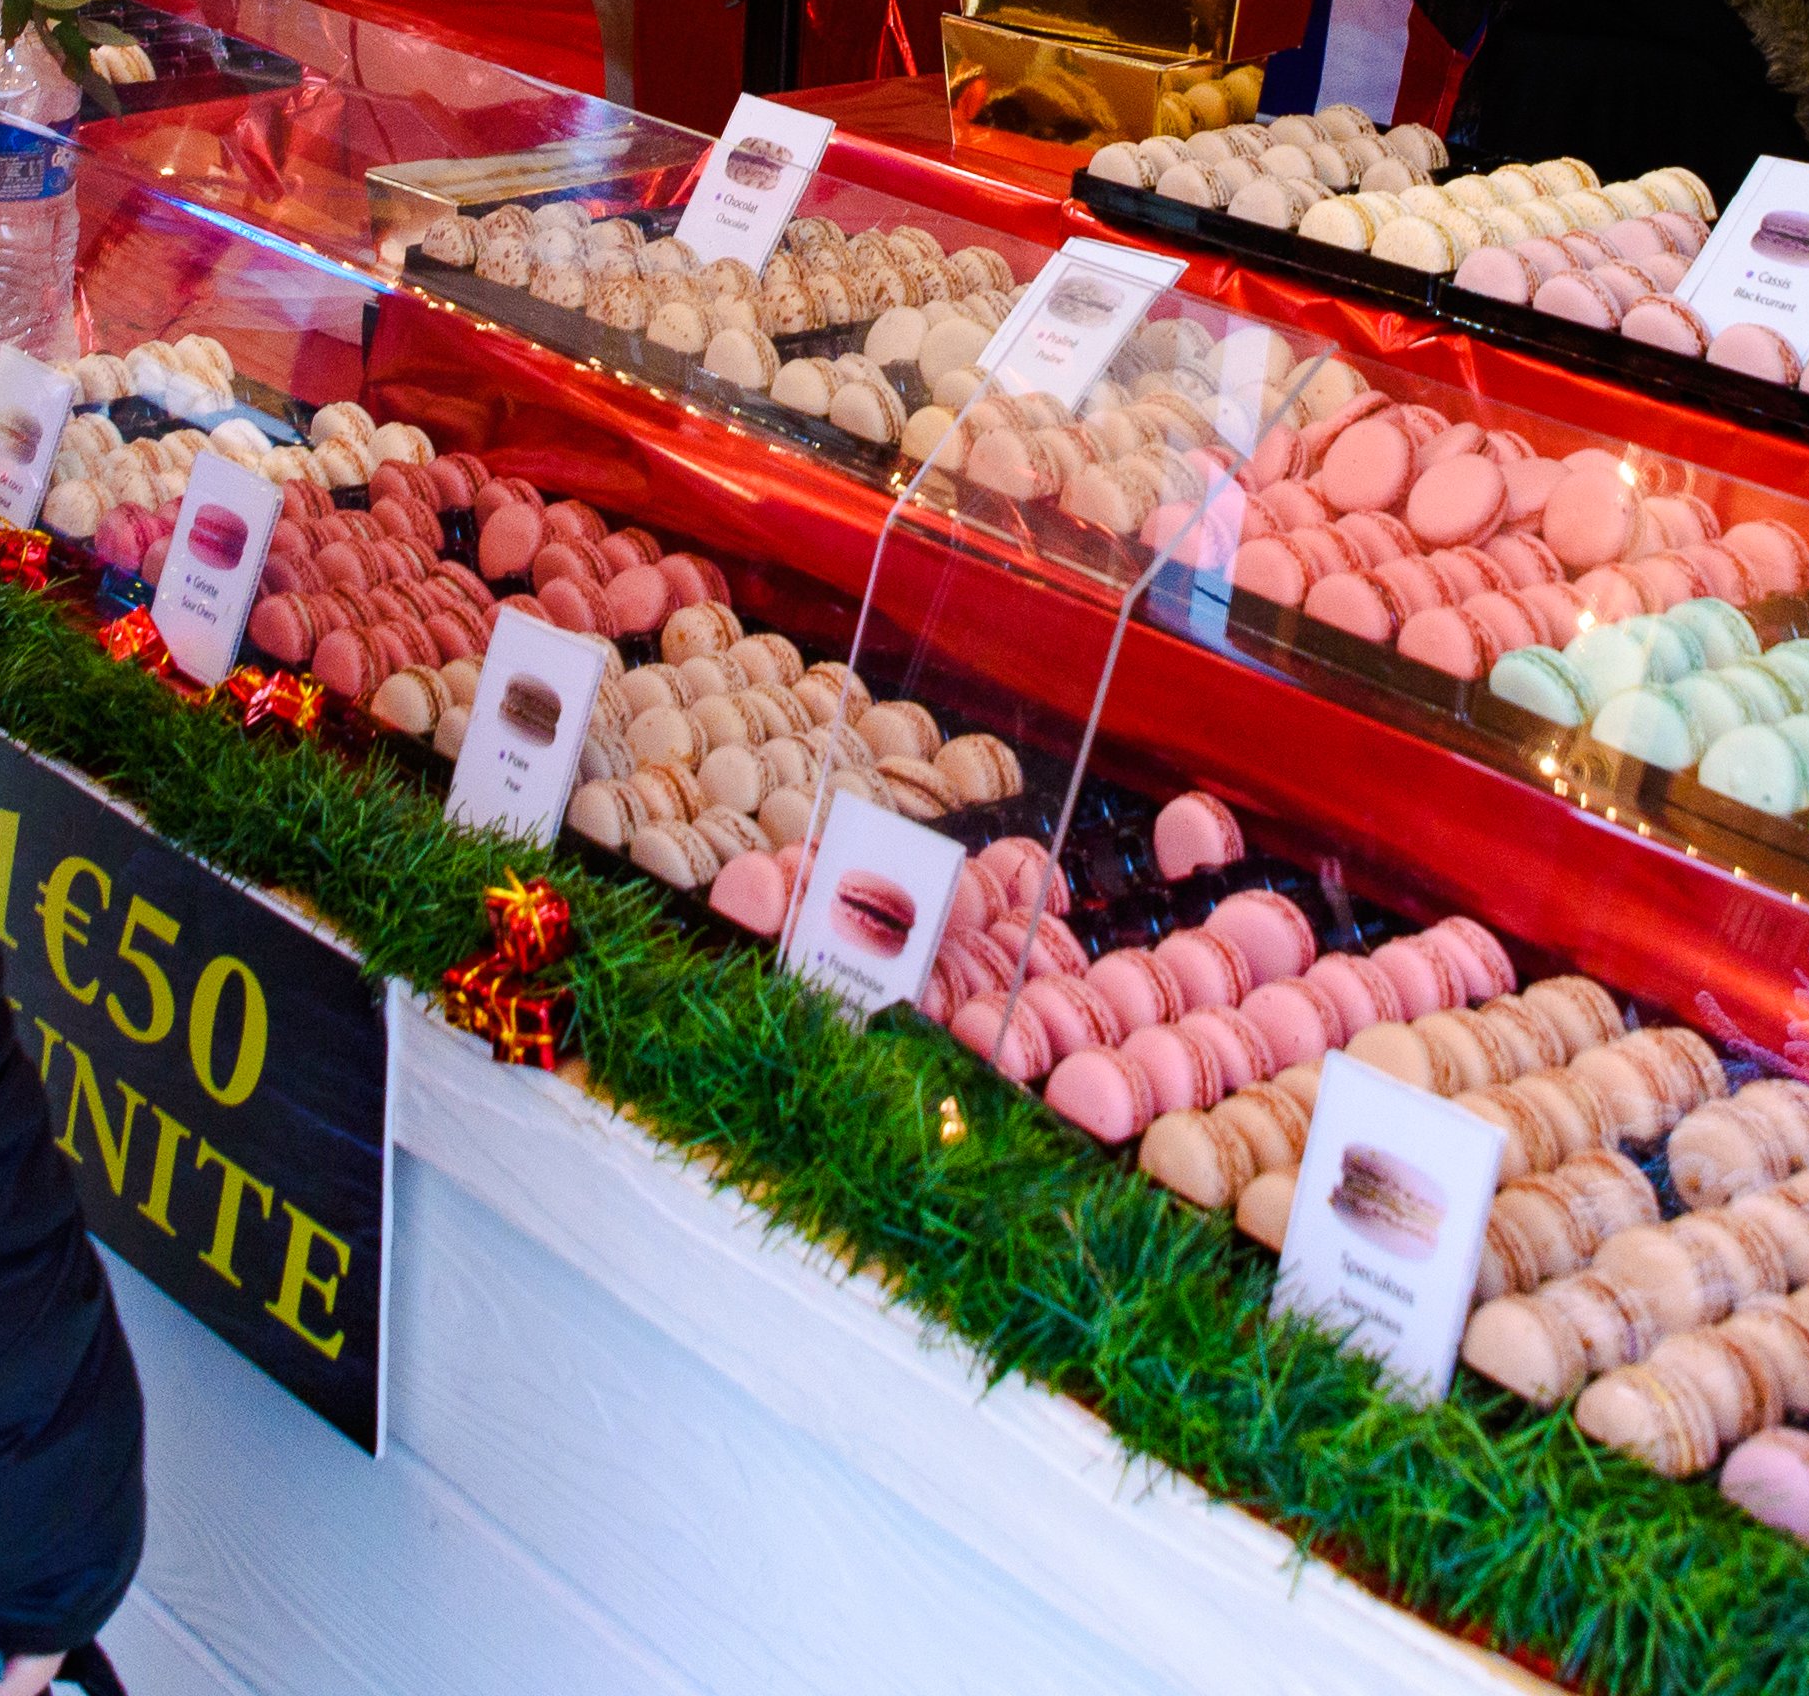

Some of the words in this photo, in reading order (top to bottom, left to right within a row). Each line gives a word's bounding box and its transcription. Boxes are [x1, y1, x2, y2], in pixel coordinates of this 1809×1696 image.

[723, 193, 759, 215] Chocolat
[716, 213, 750, 232] Chocolate
[1757, 271, 1792, 290] Cassis
